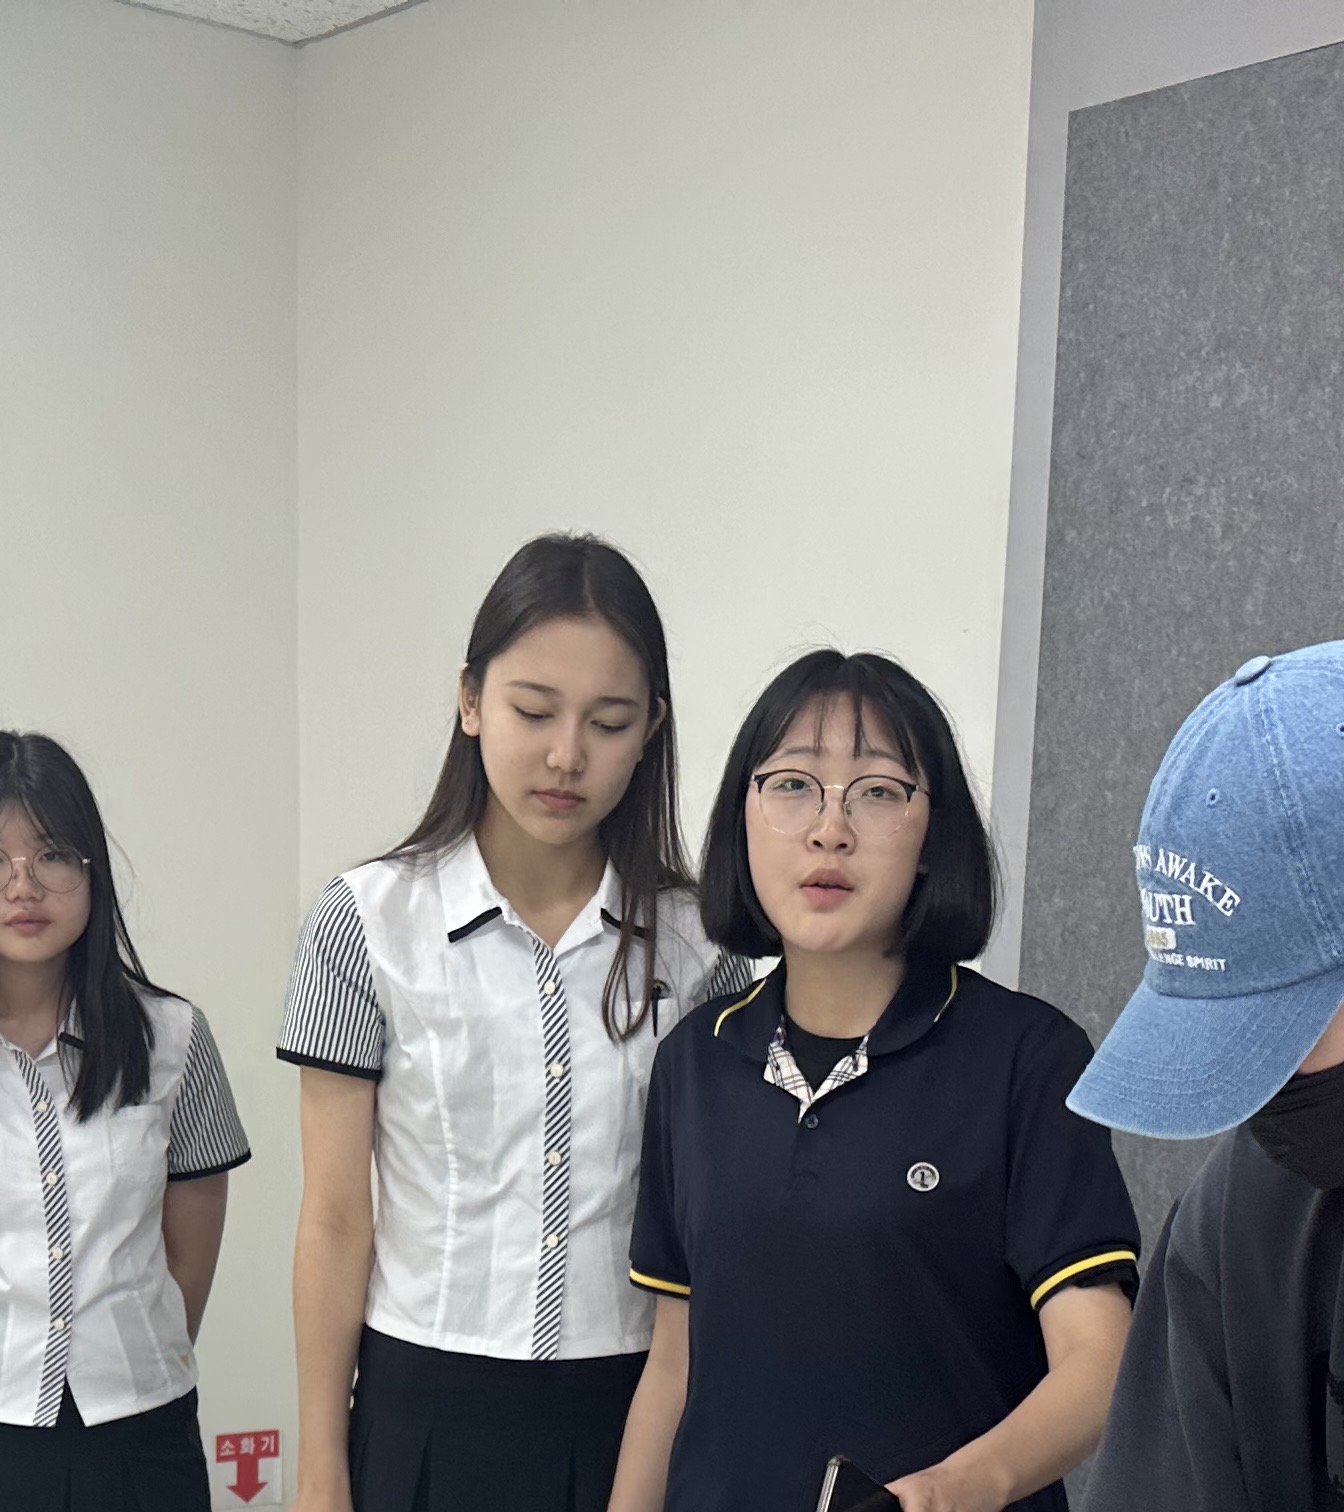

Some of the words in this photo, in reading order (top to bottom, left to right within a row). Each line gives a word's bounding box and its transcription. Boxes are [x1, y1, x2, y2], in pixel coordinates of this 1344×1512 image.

[1155, 848, 1241, 917] AWAKE
[1185, 954, 1227, 972] SPIRIT
[219, 1435, 276, 1457] 소화기
